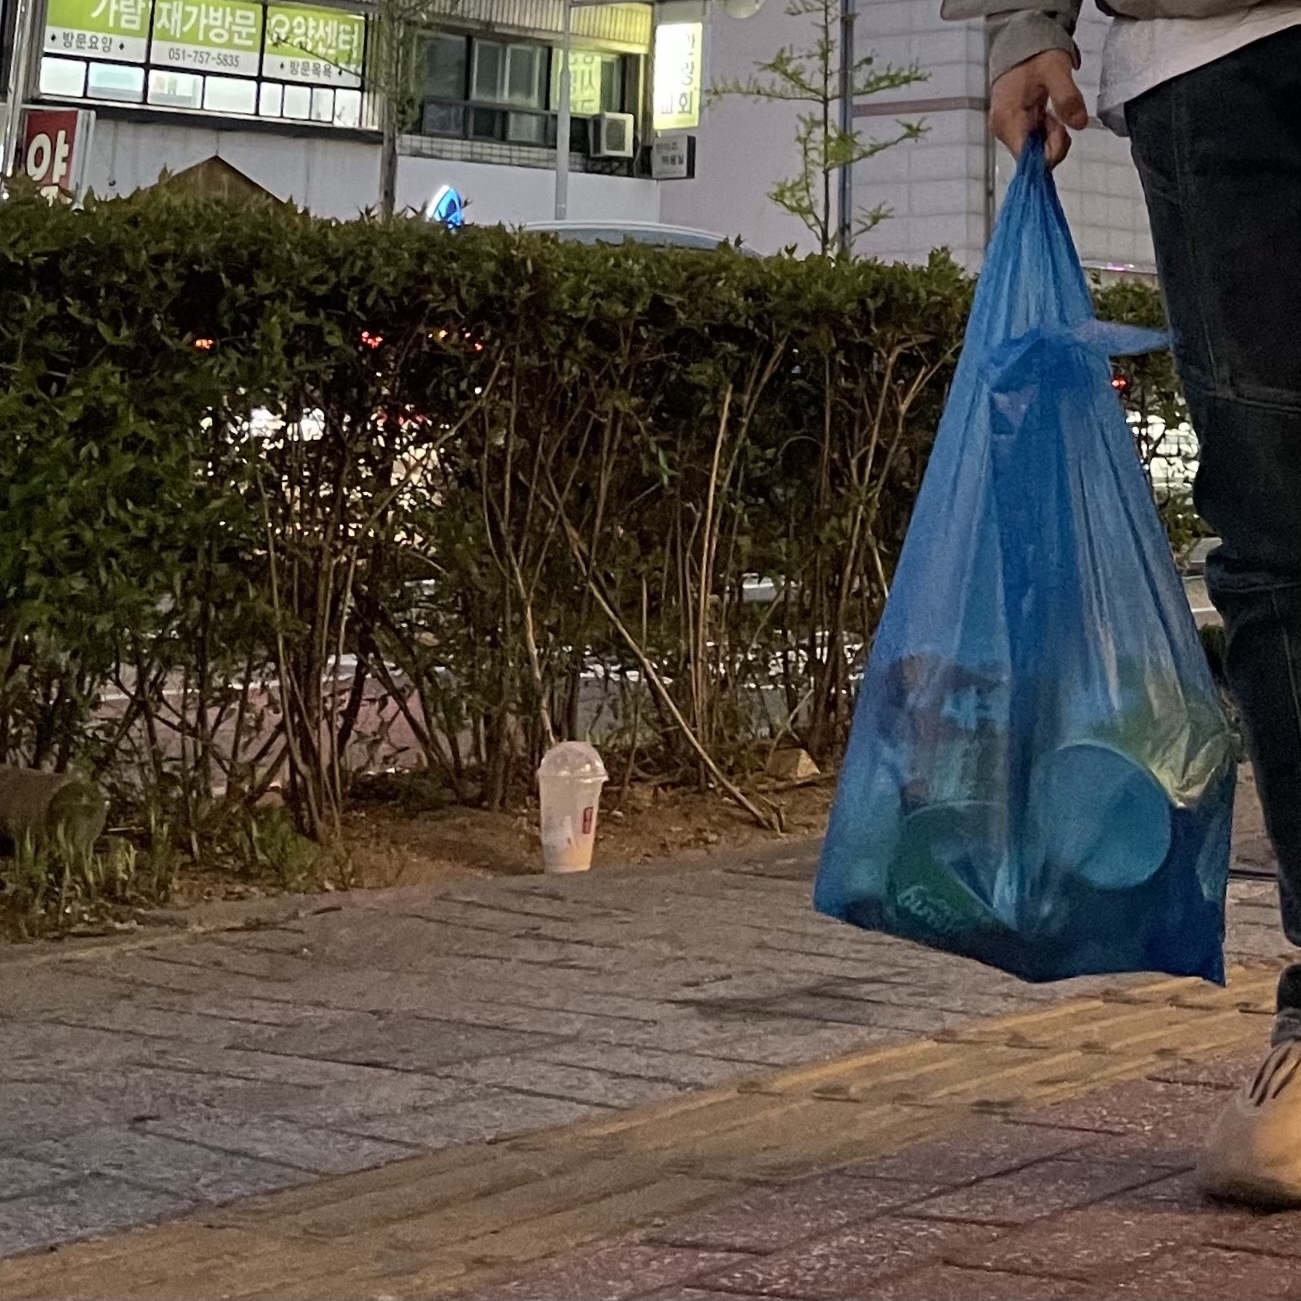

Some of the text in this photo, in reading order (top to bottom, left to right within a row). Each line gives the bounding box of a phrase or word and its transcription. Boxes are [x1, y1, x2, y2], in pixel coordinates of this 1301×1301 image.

[156, 0, 257, 47] 재가방문
[267, 13, 361, 60] 요양센터
[62, 31, 113, 53] 방문요양
[168, 47, 240, 68] 051-757-5835
